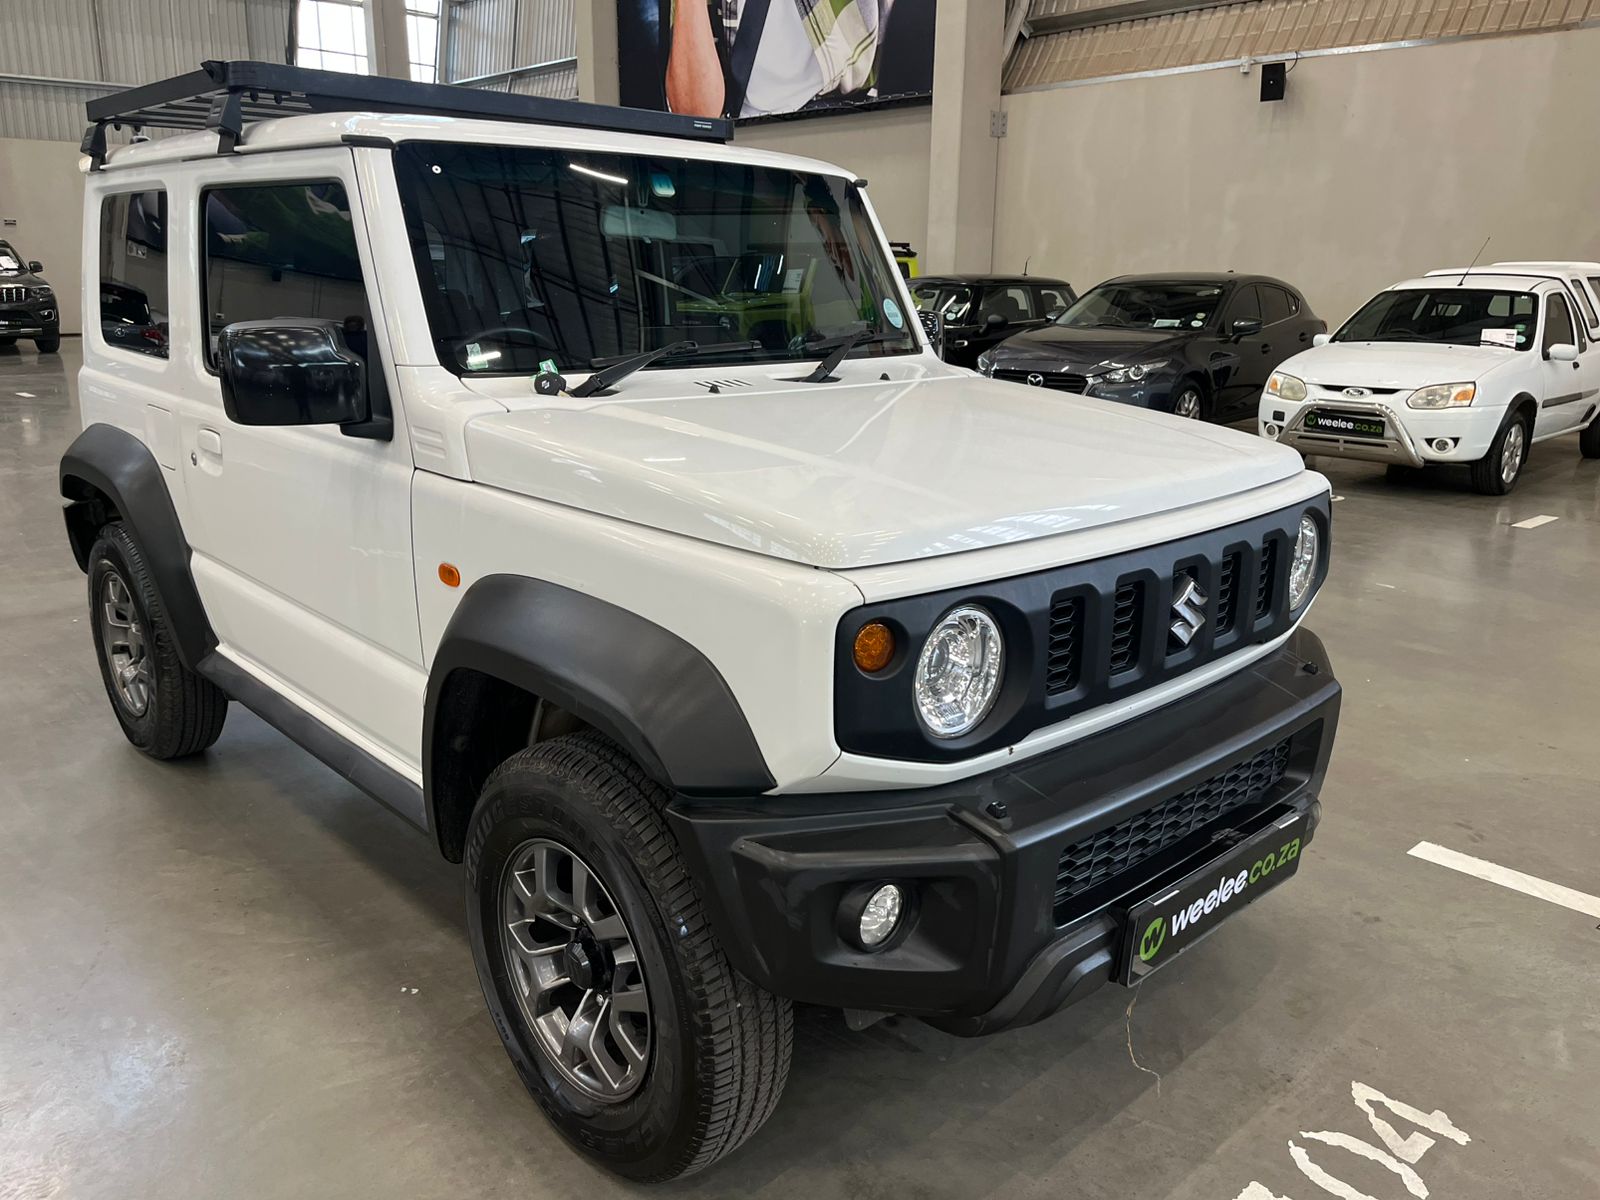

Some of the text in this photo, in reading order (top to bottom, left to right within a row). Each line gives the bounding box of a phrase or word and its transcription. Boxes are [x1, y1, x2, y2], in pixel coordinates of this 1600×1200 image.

[1317, 417, 1383, 433] weelee.co.za
[1171, 837, 1300, 937] weelee.co.za
[1232, 1080, 1472, 1200] 04
